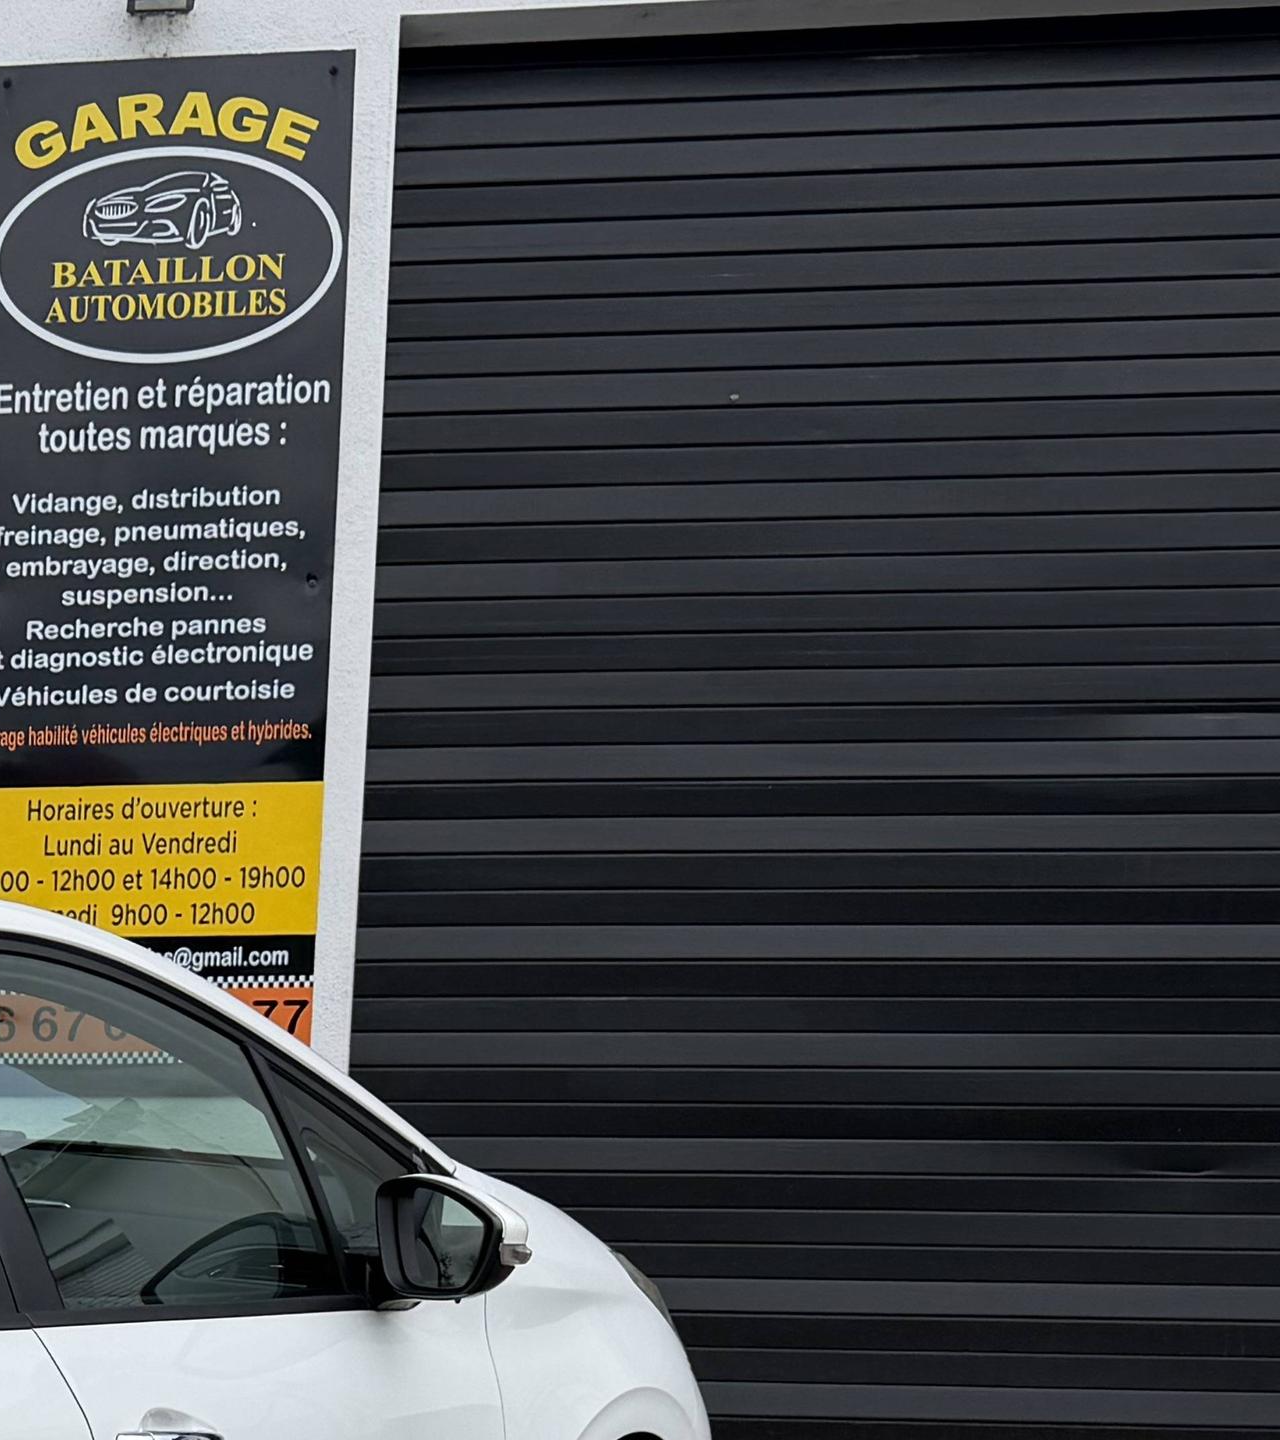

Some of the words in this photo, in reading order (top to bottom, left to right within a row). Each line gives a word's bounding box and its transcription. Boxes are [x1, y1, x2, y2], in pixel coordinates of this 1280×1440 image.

[14, 91, 320, 169] GARAGE
[51, 253, 286, 289] BATAILLON
[44, 288, 287, 324] AUTOMOBILES
[138, 379, 167, 410] et
[175, 373, 331, 414] réparation
[39, 421, 131, 453] toutes
[140, 424, 270, 456] marques
[12, 492, 124, 517] Vidange,
[132, 485, 281, 511] distribution
[114, 518, 306, 548] pneumatiques,
[5, 554, 155, 580] embrayage,
[163, 549, 288, 574] direction,
[61, 582, 233, 609] suspension...
[26, 618, 164, 641] Recherche
[171, 614, 266, 640] pannes
[10, 645, 144, 674] diagnostic
[151, 641, 314, 667] électronique
[125, 683, 157, 703] de
[164, 678, 296, 702] courtoisie
[28, 723, 78, 747] habilité
[81, 722, 146, 745] véhicules
[149, 720, 228, 747] électriques
[231, 722, 245, 742] et
[248, 718, 312, 743] hybrides.
[27, 798, 114, 822] Horaires
[43, 833, 102, 857] Lundi
[109, 838, 134, 855] au
[141, 830, 238, 855] Vendredi
[52, 868, 116, 892] 12h00
[122, 870, 143, 890] et
[150, 867, 217, 890] 14h00
[239, 866, 306, 889] 19h00
[111, 903, 168, 926] 9h00
[190, 902, 255, 925] 12h00
[32, 1006, 85, 1042] 67
